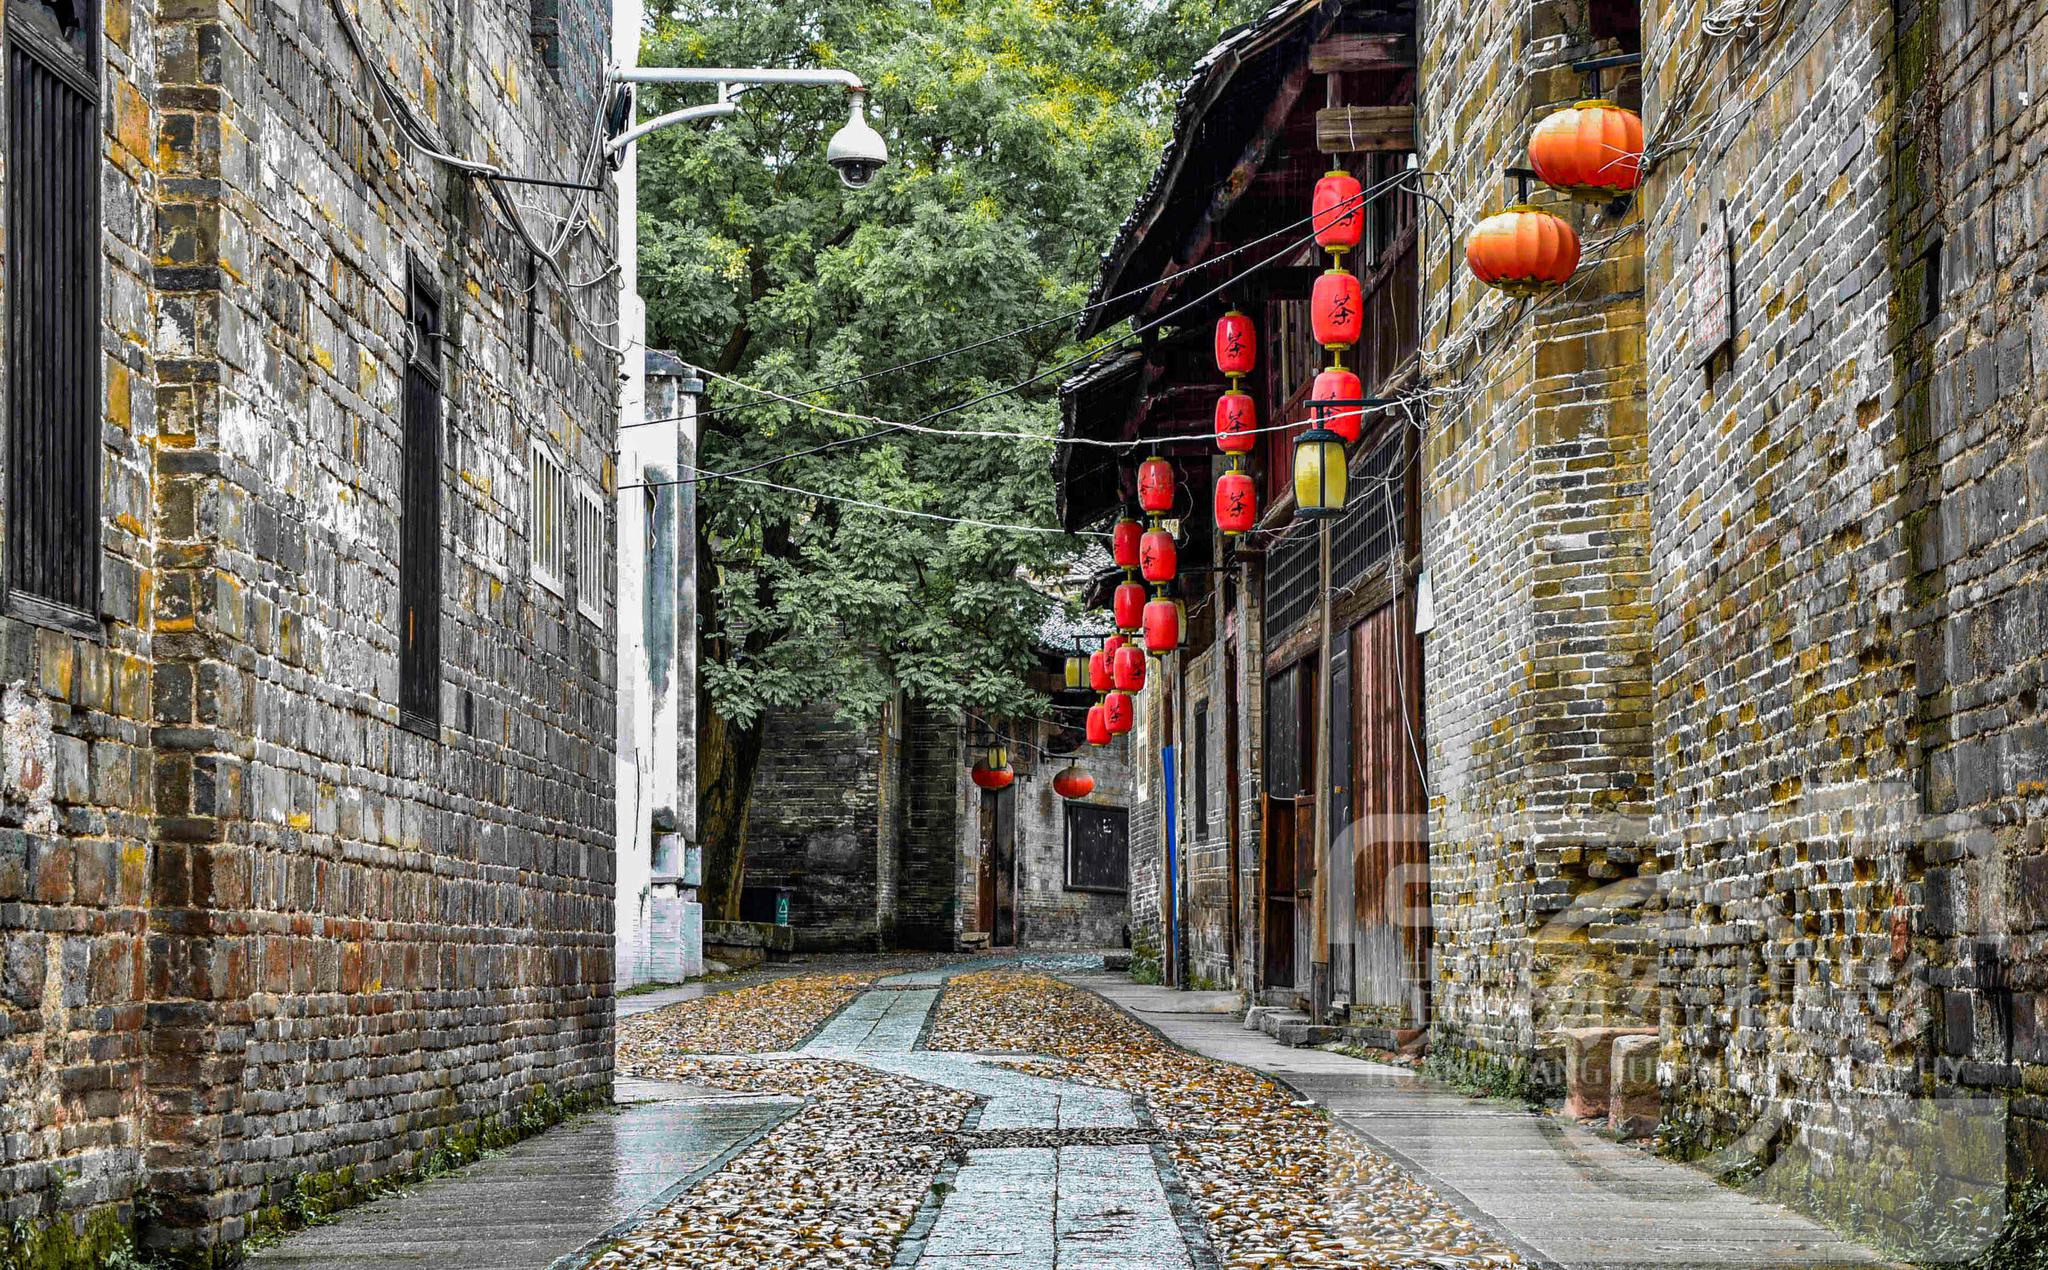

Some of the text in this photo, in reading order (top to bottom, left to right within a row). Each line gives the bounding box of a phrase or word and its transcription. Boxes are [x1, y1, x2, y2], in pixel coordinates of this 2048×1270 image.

[1328, 293, 1356, 326] 茶
[1224, 331, 1247, 359] 茶
[1225, 490, 1248, 517] 茶
